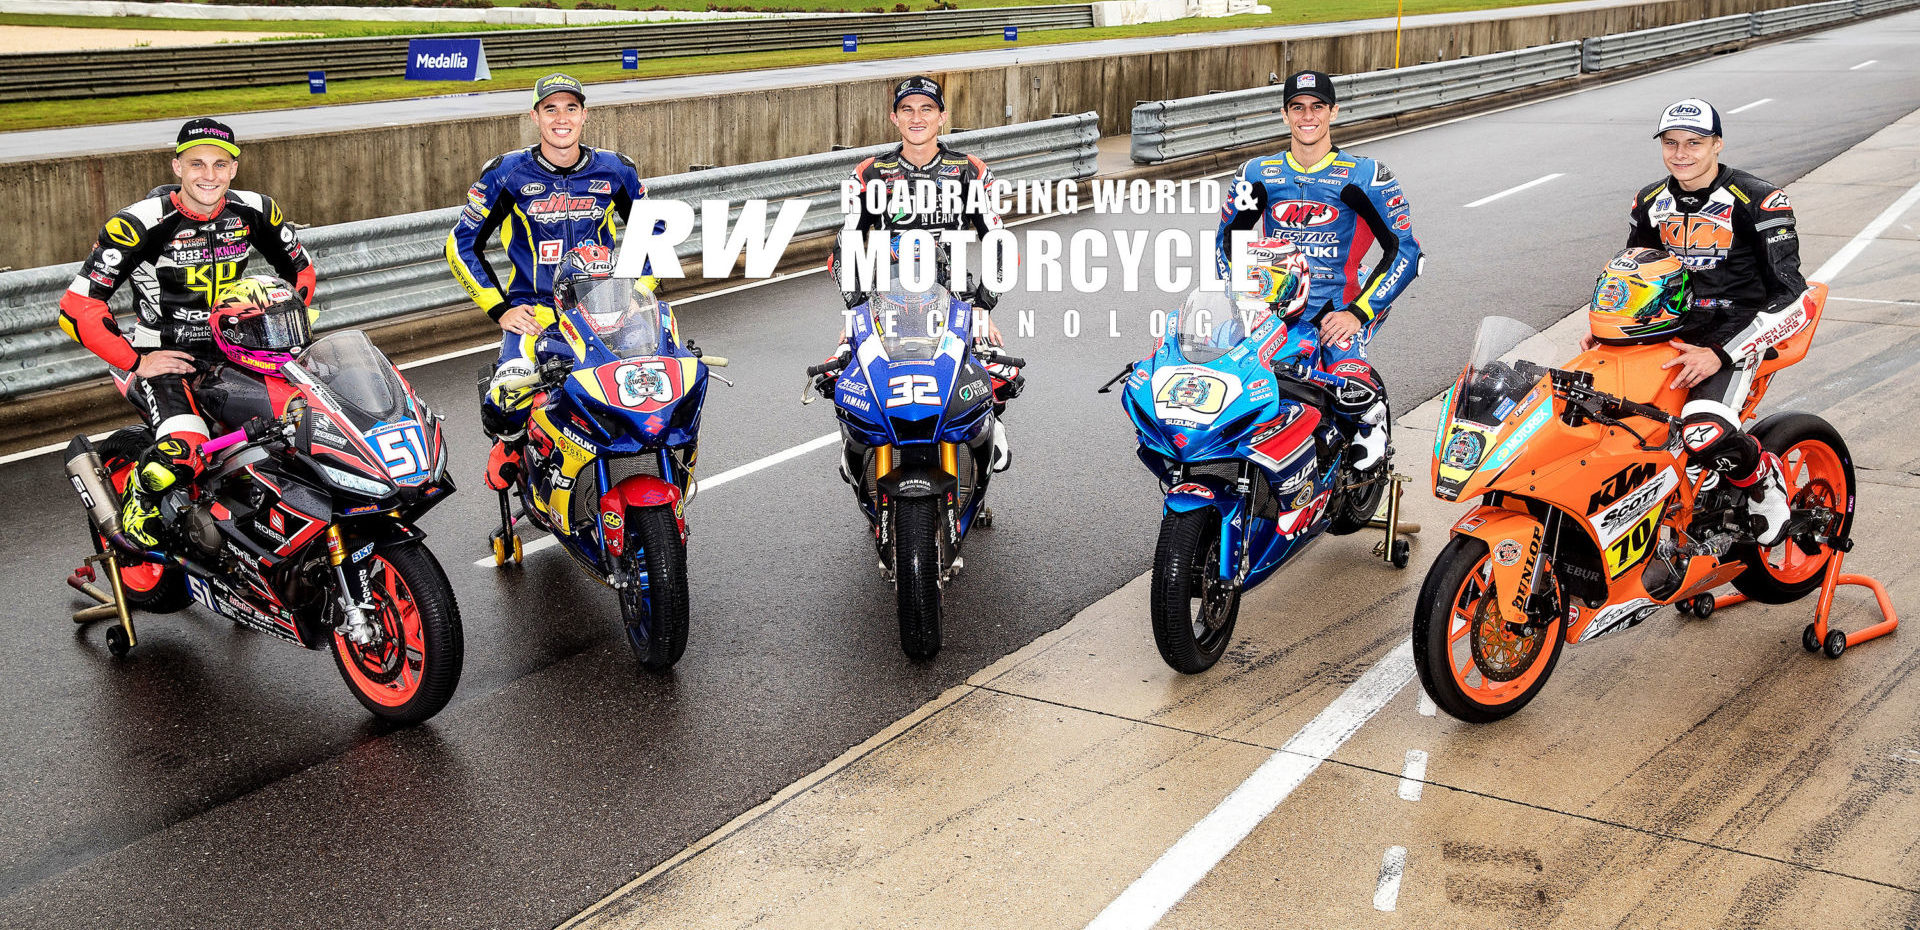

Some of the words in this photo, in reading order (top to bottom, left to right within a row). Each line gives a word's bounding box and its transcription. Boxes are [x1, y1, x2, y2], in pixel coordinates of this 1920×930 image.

[416, 52, 468, 69] Medallia
[1670, 104, 1697, 113] Arai
[525, 184, 543, 192] Arai
[1272, 229, 1340, 244] ECSTAR
[1660, 216, 1734, 250] KTM
[587, 262, 611, 271] Arai
[1614, 259, 1635, 268] Arai
[450, 260, 481, 298] CORTECH
[1376, 258, 1408, 299] SUZUKI
[272, 291, 290, 299] BELL
[1755, 326, 1778, 345] RICH
[1778, 309, 1804, 330] LONG
[1766, 321, 1800, 346] RACING
[1333, 363, 1370, 375] RST
[842, 393, 871, 413] YAMAHA
[885, 373, 942, 409] 32
[313, 428, 348, 447] ROBEM
[1166, 418, 1197, 429] SUZUKI
[1506, 407, 1550, 451] MOTOREX
[375, 426, 430, 479] 51
[563, 426, 597, 455] SUZUKI
[906, 479, 931, 487] YAMAHA
[1585, 462, 1657, 518] KTM
[1600, 481, 1664, 528] SCOTT
[254, 520, 292, 547] ROBEM
[881, 510, 889, 544] DUNLOP
[947, 509, 957, 544] DUNLOP
[227, 541, 259, 569] aprilia
[352, 542, 375, 563] SKF
[1611, 517, 1651, 568] 70
[1511, 525, 1542, 612] DUNLOP
[187, 574, 215, 612] 51
[359, 569, 372, 604] DUNLOP
